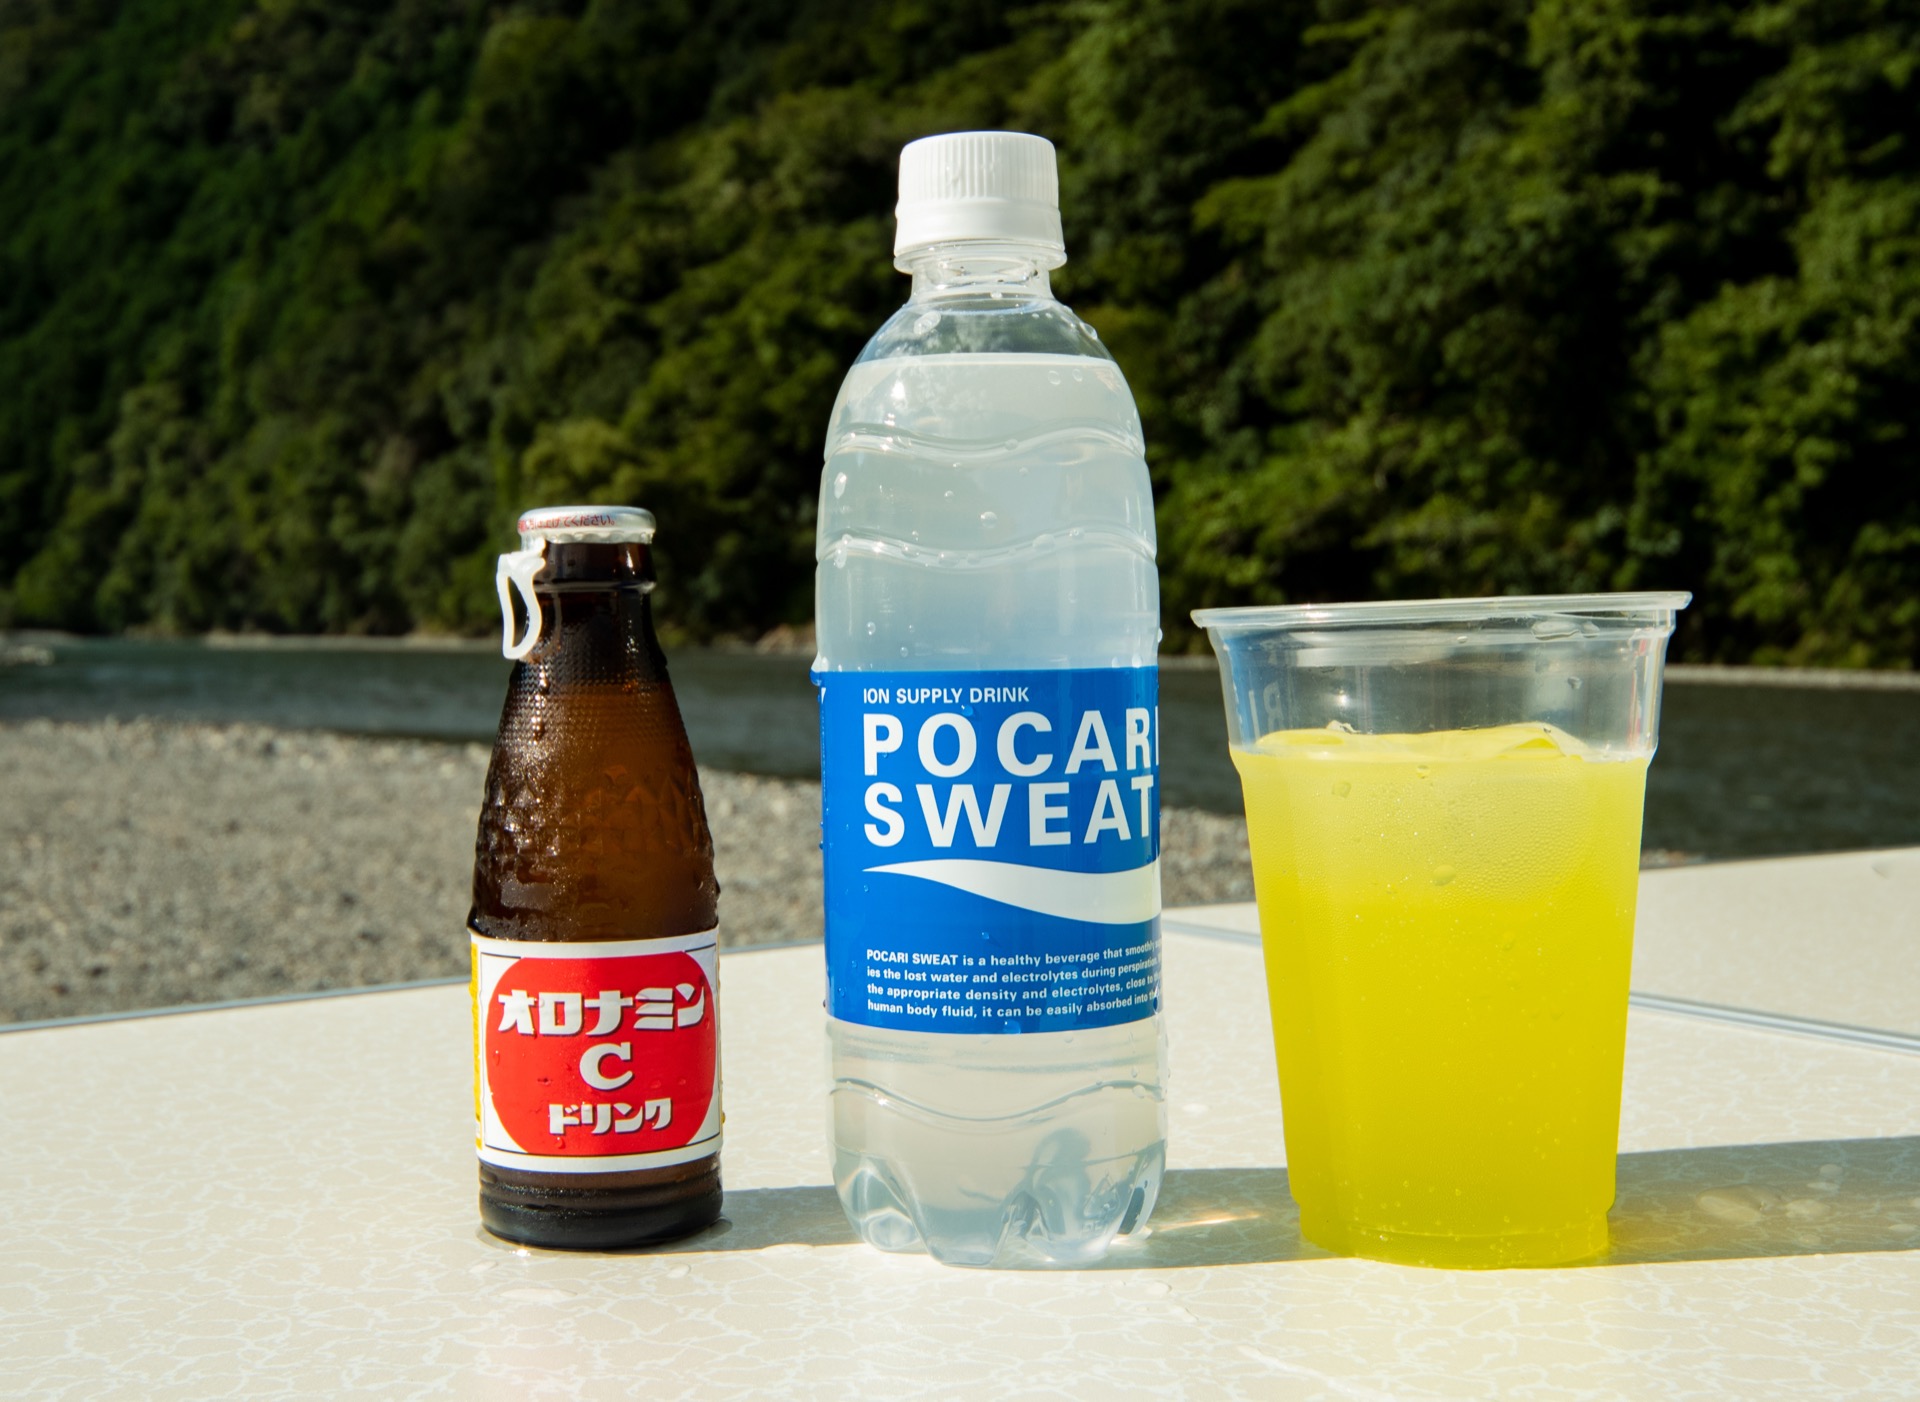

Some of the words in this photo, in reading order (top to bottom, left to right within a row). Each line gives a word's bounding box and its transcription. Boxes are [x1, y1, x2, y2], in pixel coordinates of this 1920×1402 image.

[863, 688, 889, 704] ION
[896, 688, 962, 704] SUPPLY
[970, 687, 1029, 703] DRINK
[863, 705, 1159, 778] POCARI
[864, 775, 1154, 847] SWEAT
[867, 949, 908, 963] POCARI
[912, 953, 958, 965] SWEAT
[963, 955, 974, 966] is
[979, 957, 986, 966] a
[991, 954, 1040, 967] healthy
[1046, 950, 1099, 964] beverage
[1103, 948, 1122, 960] that
[867, 966, 880, 978] ies
[883, 968, 901, 980] the
[904, 970, 926, 982] lost
[931, 974, 968, 983] water
[973, 972, 997, 983] and
[1002, 970, 1078, 983] electrolytes
[1082, 966, 1115, 978] during
[867, 983, 883, 995] the
[887, 988, 960, 1000] appropriate
[965, 989, 1017, 1002] density
[1022, 988, 1047, 999] and
[1052, 983, 1123, 997] electrolytes,
[1126, 978, 1145, 990] close
[1147, 975, 1153, 984] to
[498, 983, 705, 1036] オロナミン
[868, 999, 903, 1014] human
[907, 1003, 937, 1018] body
[942, 1005, 977, 1018] fluid,
[982, 1006, 992, 1017] it
[997, 1008, 1021, 1017] can
[1026, 1005, 1042, 1017] be
[1046, 1003, 1082, 1015] easily
[1086, 995, 1132, 1012] absorbed
[1134, 993, 1148, 1005] into
[579, 1042, 633, 1090] C
[549, 1098, 671, 1134] ドリンク
